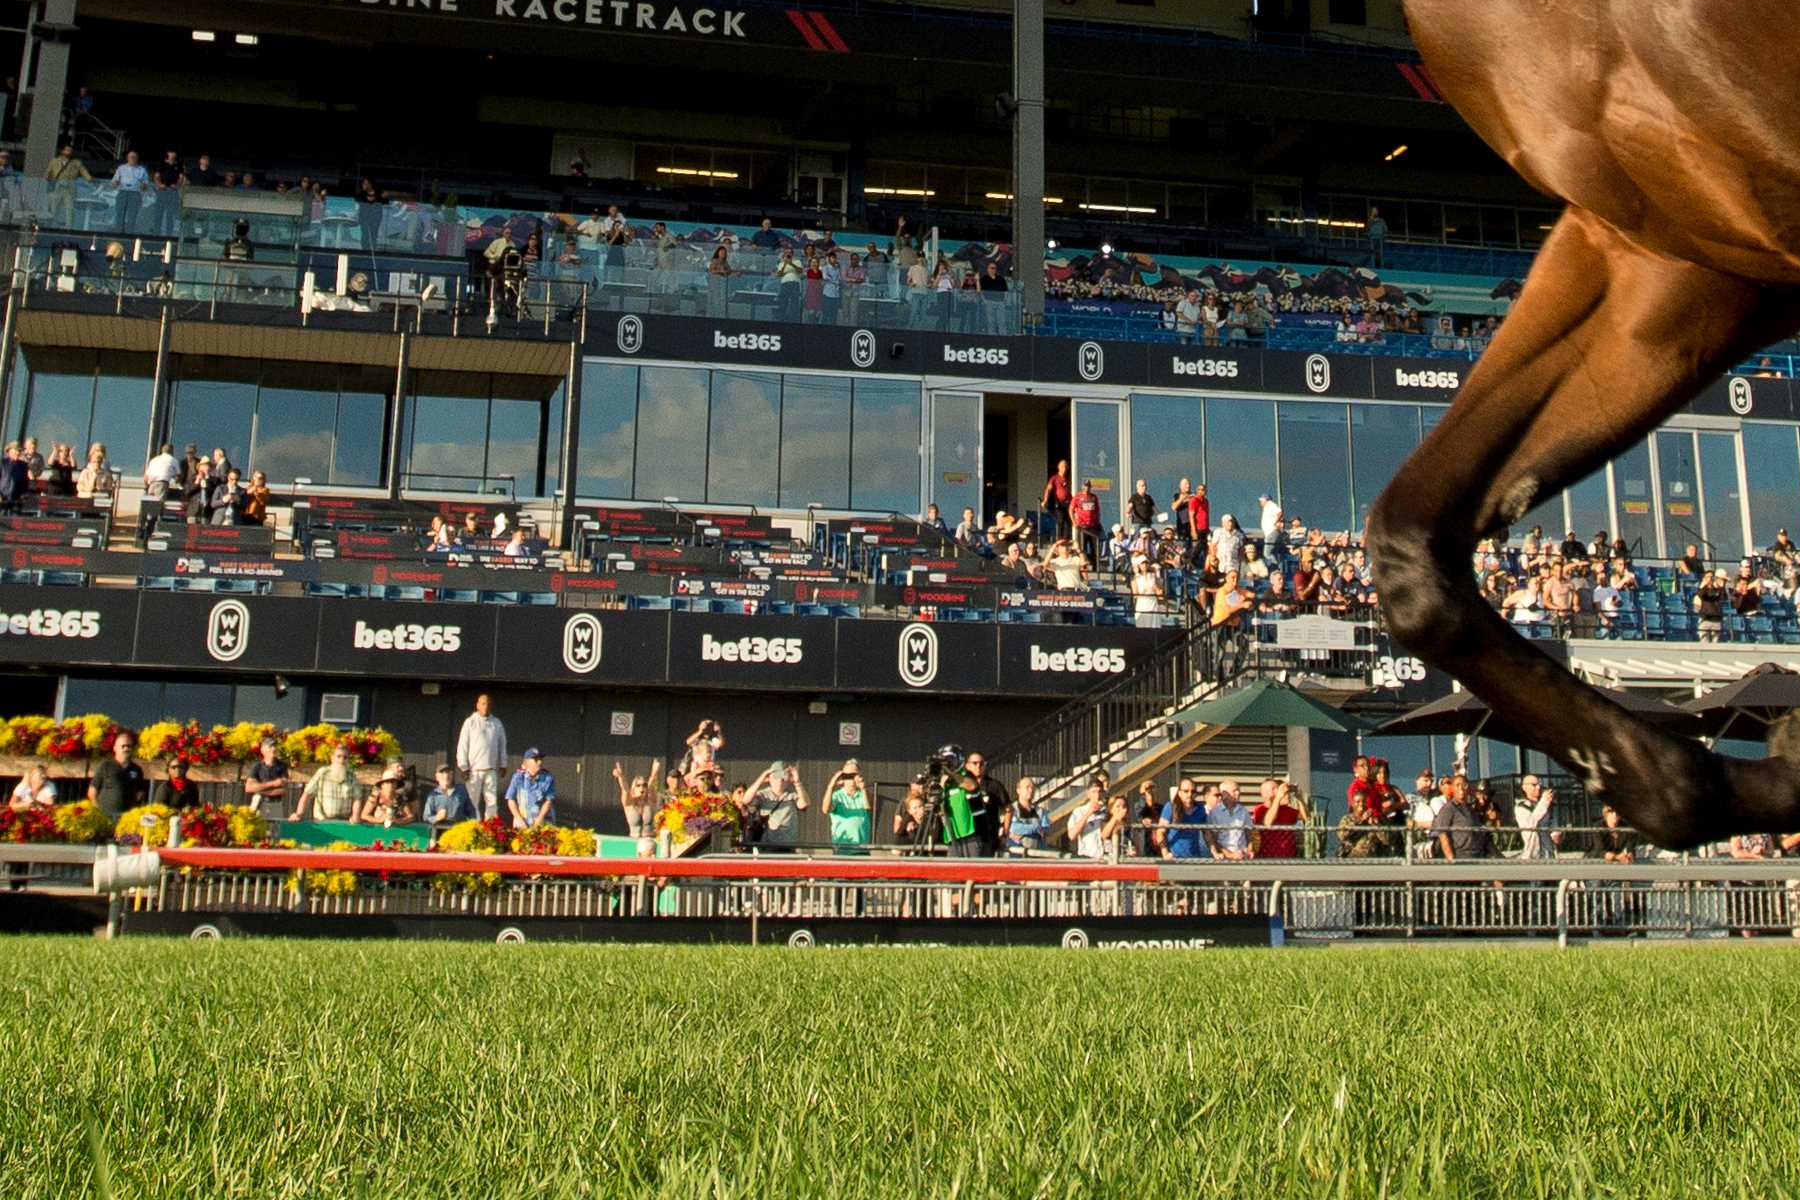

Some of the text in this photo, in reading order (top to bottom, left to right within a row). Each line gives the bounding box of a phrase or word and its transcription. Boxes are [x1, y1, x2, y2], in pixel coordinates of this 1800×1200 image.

[713, 330, 782, 352] bet365
[943, 344, 1009, 366] bet365
[1172, 356, 1239, 378] bet365
[1395, 368, 1459, 389] bet365
[220, 614, 239, 630] W
[353, 620, 461, 652] bet365
[573, 627, 592, 643] W
[909, 638, 928, 654] W
[701, 633, 803, 664] bet365
[1030, 644, 1126, 673] bet365
[1378, 656, 1426, 681] 365
